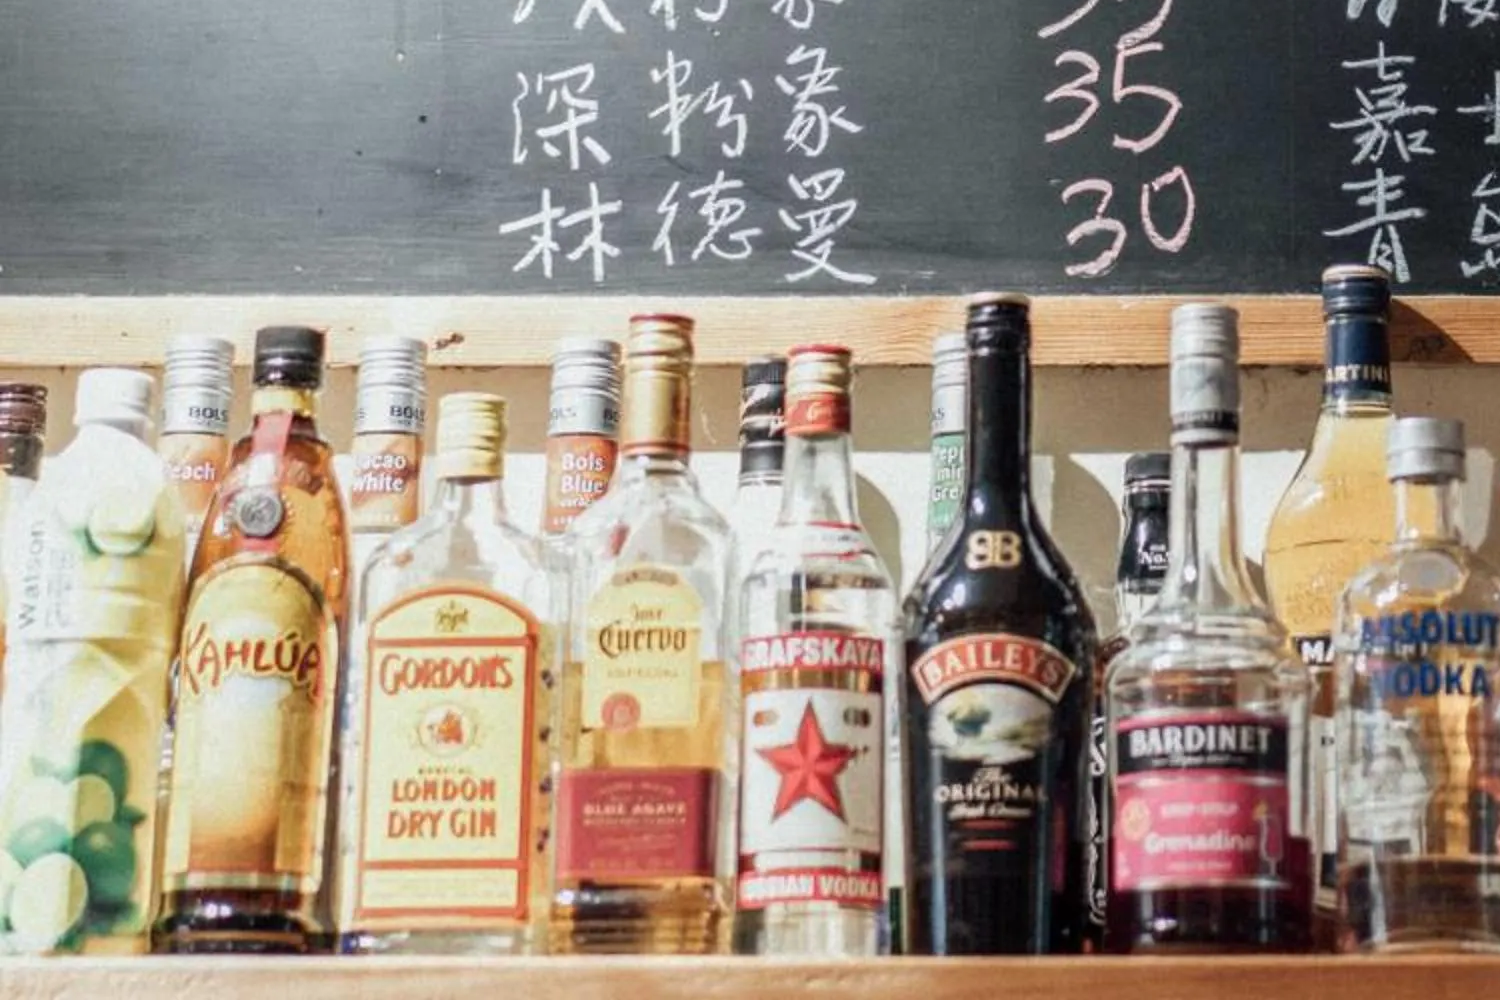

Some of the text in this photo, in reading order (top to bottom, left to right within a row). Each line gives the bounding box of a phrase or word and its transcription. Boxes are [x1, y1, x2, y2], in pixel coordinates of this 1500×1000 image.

[512, 43, 1183, 170] 深粉象 35
[499, 166, 1196, 284] 林德曼 30
[561, 451, 606, 471] Bols
[598, 620, 688, 660] Cuervo
[1361, 610, 1500, 648] ABSOLUT
[182, 621, 325, 700] KAHLÚA
[921, 641, 1063, 687] BAILEYS
[1371, 661, 1491, 699] VODKA
[1129, 724, 1273, 759] BARDINET
[391, 777, 497, 802] LONDON
[933, 782, 1046, 804] ORIGINAL
[387, 809, 497, 839] DRY GIN
[1143, 830, 1256, 855] Grenadine
[818, 873, 879, 899] VODKA
